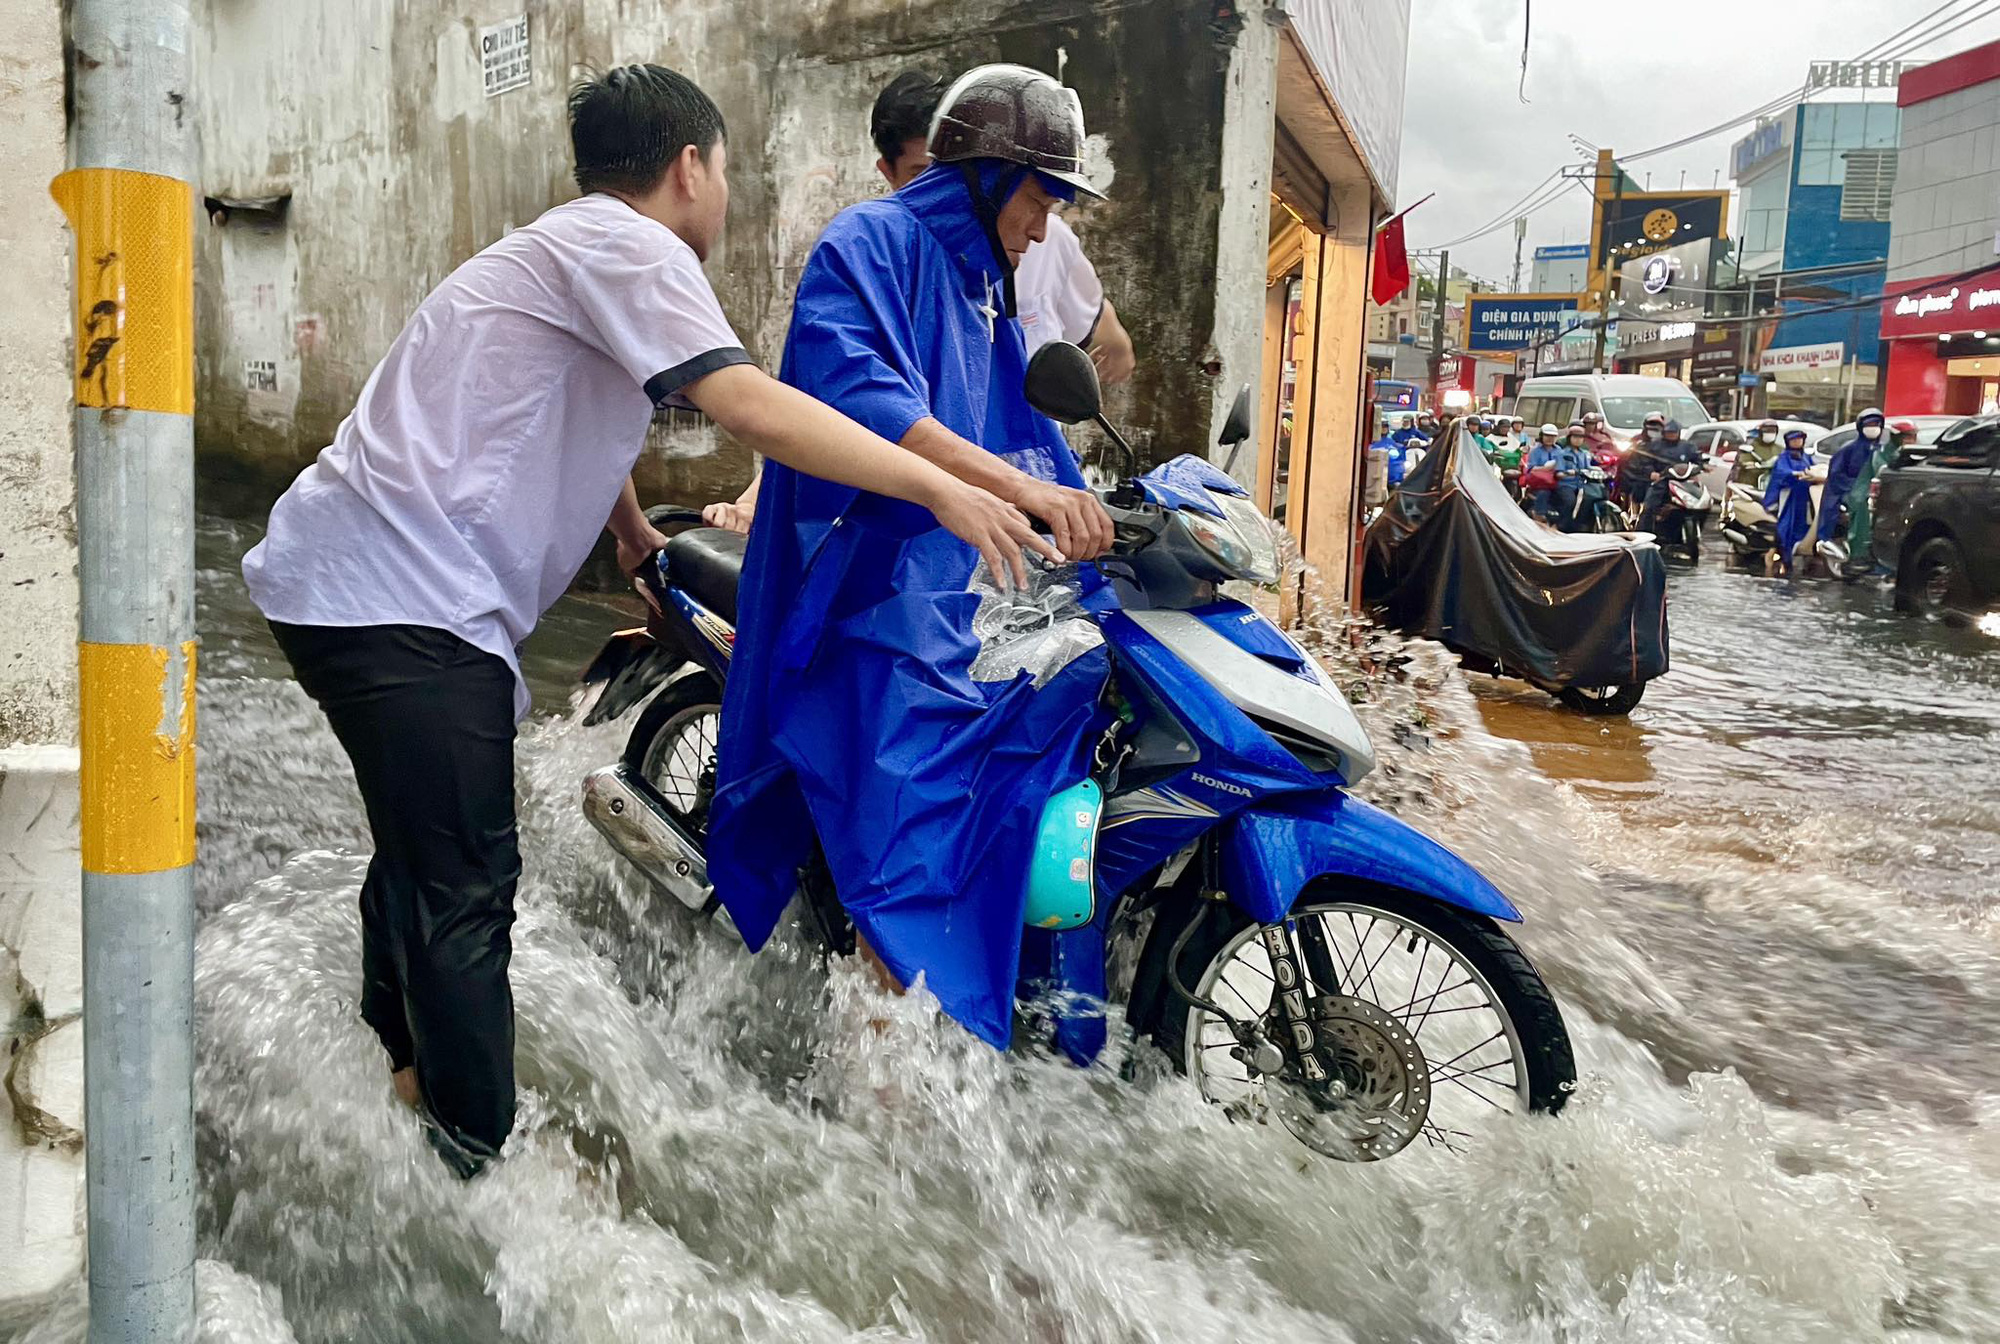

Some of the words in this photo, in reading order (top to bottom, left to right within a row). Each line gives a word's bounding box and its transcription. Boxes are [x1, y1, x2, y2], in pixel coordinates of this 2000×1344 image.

[1482, 309, 1508, 325] ĐIỆN
[1511, 311, 1530, 323] GIA
[1489, 326, 1523, 341] CHÍNH
[1777, 353, 1794, 365] KHOA
[1191, 771, 1254, 798] HONDA
[1264, 926, 1327, 1080] HONDA
